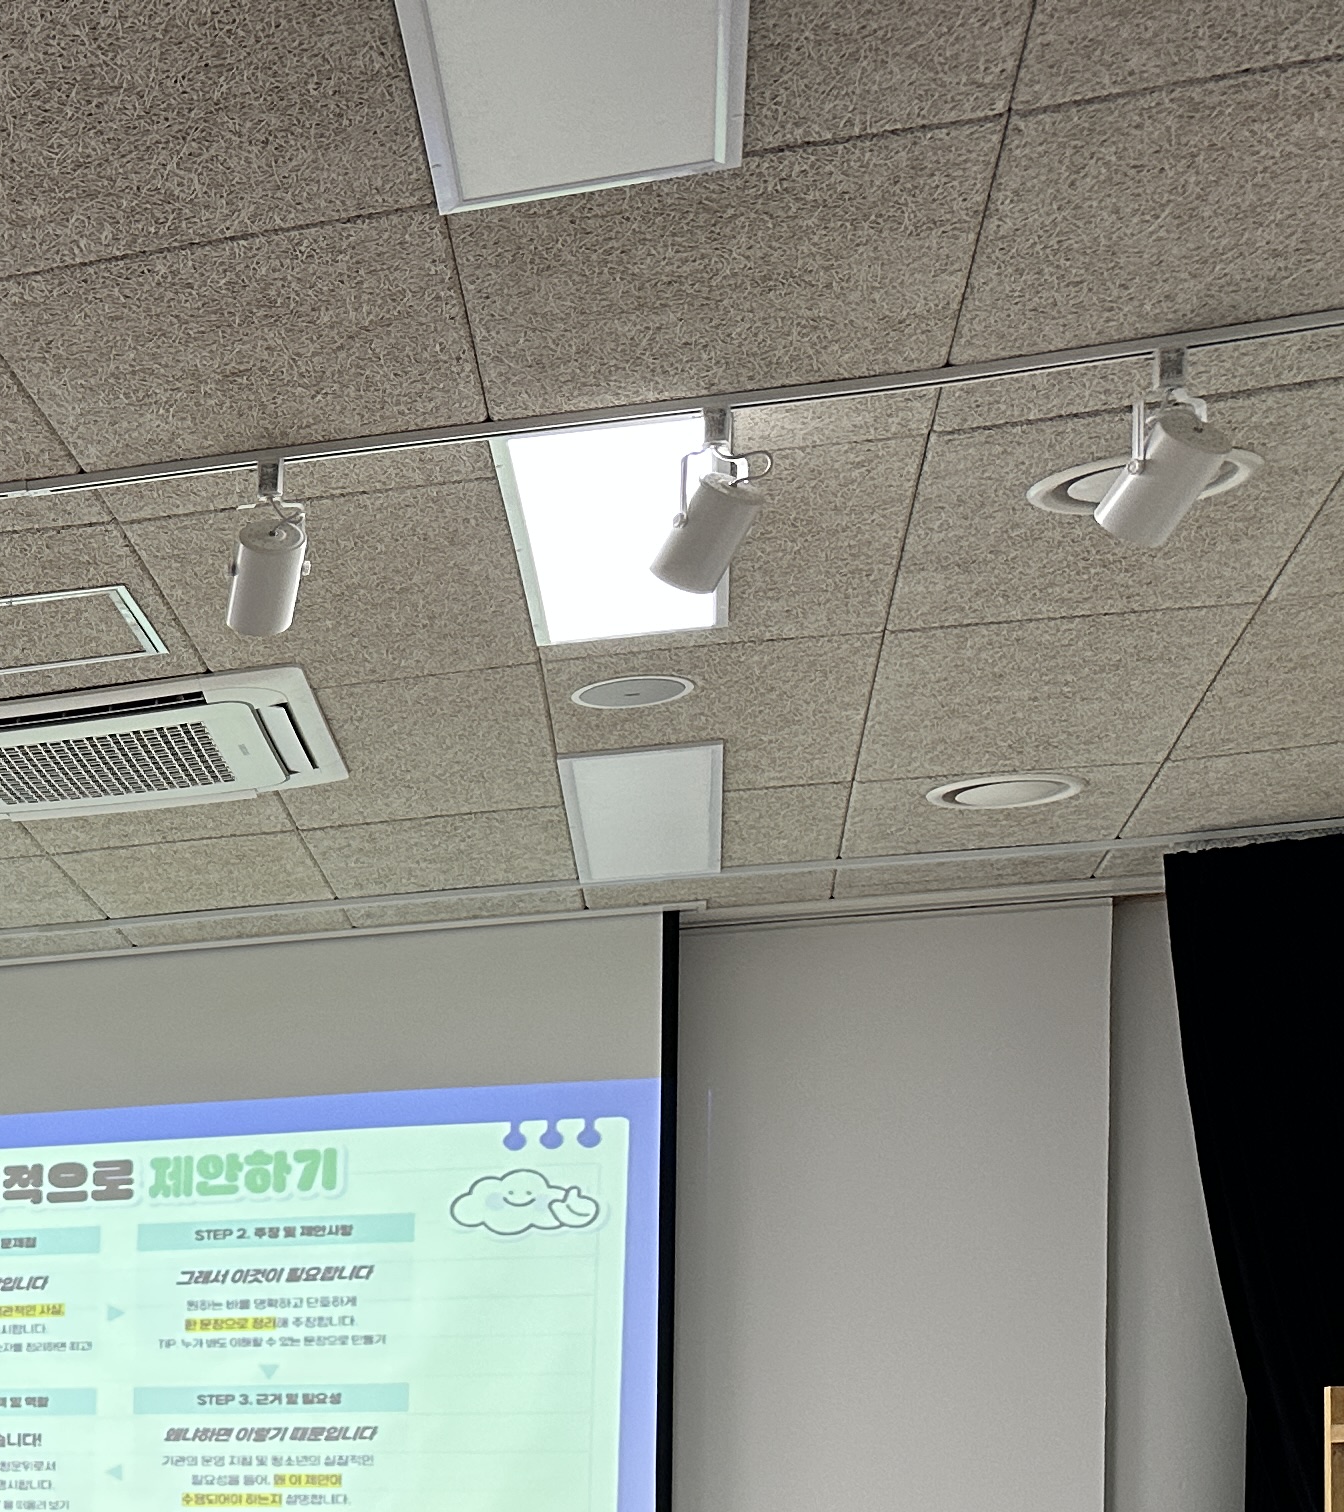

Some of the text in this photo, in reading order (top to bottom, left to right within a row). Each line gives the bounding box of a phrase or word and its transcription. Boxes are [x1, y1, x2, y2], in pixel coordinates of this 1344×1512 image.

[149, 1147, 337, 1199] 제안하기
[195, 1228, 233, 1241] STEP
[237, 1228, 250, 1240] 2.
[254, 1227, 280, 1239] 주장
[300, 1224, 353, 1238] 제안사항
[176, 1264, 375, 1285] 그래서 이것이 필요합니다
[186, 1295, 358, 1311] 원하는 바를 명확하고 단호하게
[185, 1319, 197, 1331] 한
[200, 1318, 249, 1330] 문장으로
[252, 1316, 289, 1329] 정리해
[181, 1338, 203, 1349] 누가
[206, 1337, 227, 1349] 봐도
[230, 1336, 263, 1348] 이해할
[265, 1336, 276, 1347] 수
[278, 1336, 301, 1347] 있는
[303, 1335, 349, 1346] 문장으로
[351, 1334, 387, 1345] 만들기
[197, 1394, 235, 1406] STEP
[238, 1394, 253, 1406] 3.
[256, 1393, 282, 1405] 근거
[302, 1392, 342, 1405] 필요성
[164, 1425, 378, 1442] 왜냐하면 이렇기 때문입니다
[162, 1454, 374, 1467] 기관의 운영 지침 및 청소년의 실질적인
[192, 1474, 239, 1486] 필요성을
[289, 1474, 302, 1486] 이
[305, 1473, 342, 1486] 제안이
[49, 1500, 70, 1510] 보기
[181, 1493, 243, 1505] 수용되어야
[245, 1493, 282, 1505] 하는지
